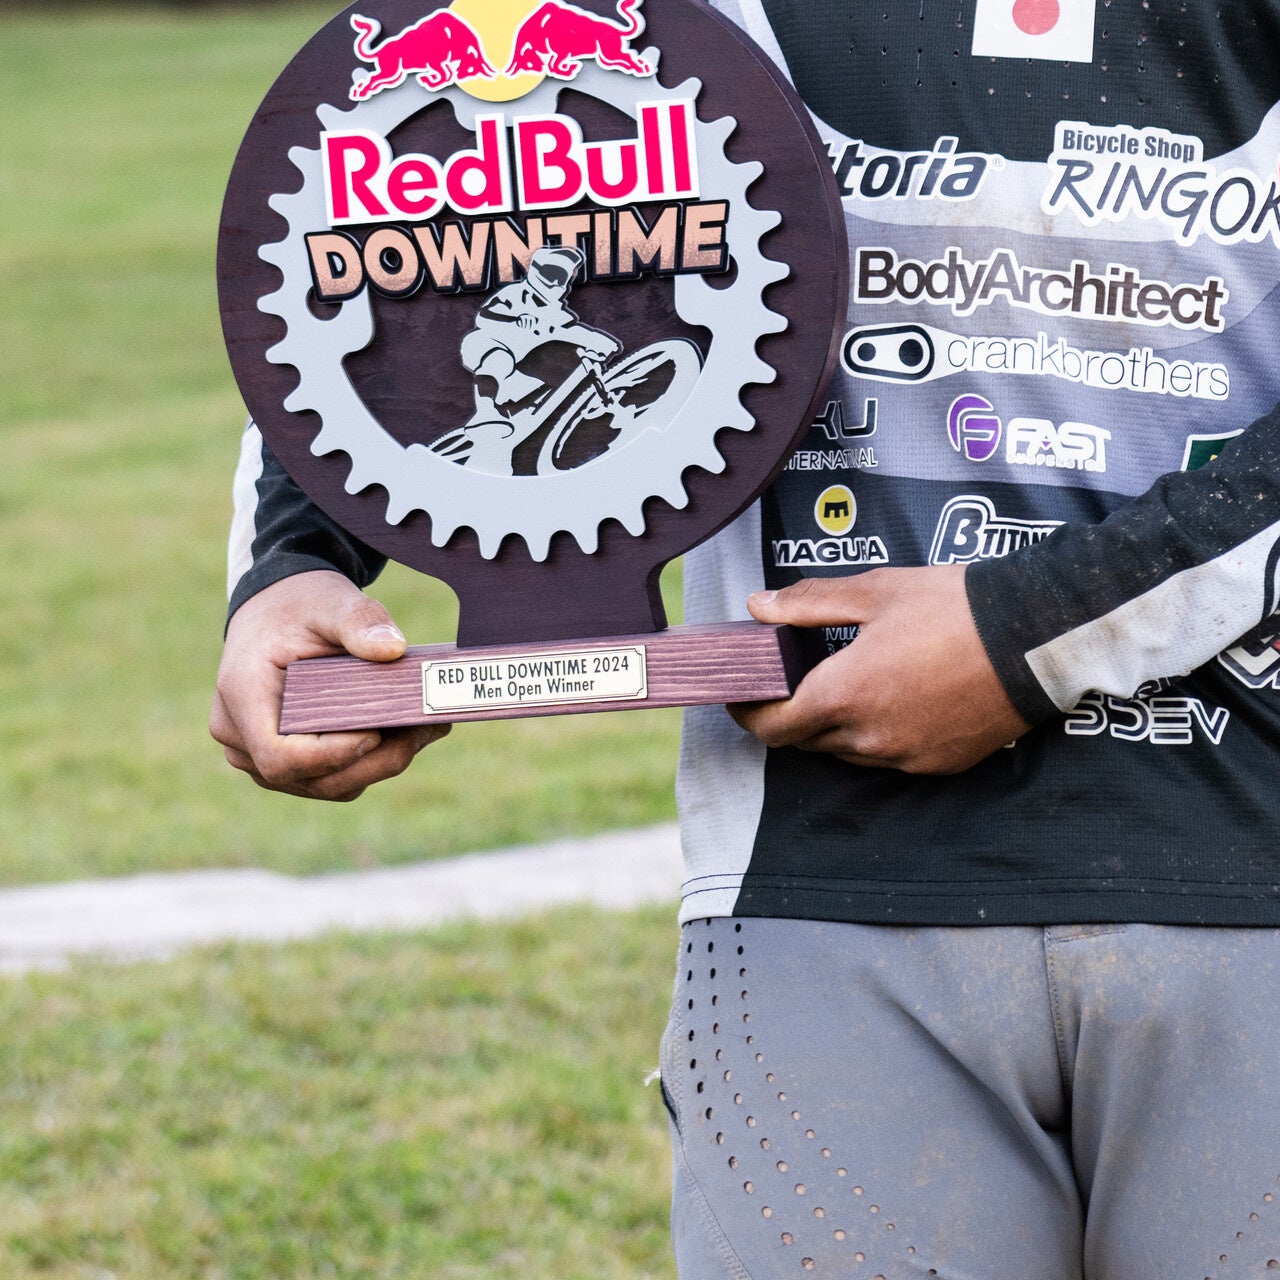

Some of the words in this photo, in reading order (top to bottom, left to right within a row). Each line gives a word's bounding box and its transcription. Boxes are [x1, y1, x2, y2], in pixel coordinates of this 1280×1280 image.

[326, 120, 504, 220] Red
[517, 104, 693, 206] Bull
[1062, 128, 1139, 158] Bicycle
[1141, 134, 1196, 163] Shop
[306, 201, 729, 298] DOWNTIME
[857, 250, 1224, 328] BodyArchitect
[947, 333, 1229, 398] crankbrothers
[1006, 418, 1112, 468] FAST
[438, 667, 464, 685] RED
[470, 665, 503, 683] BULL
[508, 658, 588, 680] DOWNTIME
[593, 655, 630, 674] 2024
[473, 683, 503, 700] Men
[507, 680, 542, 701] Open
[547, 678, 595, 695] Winner
